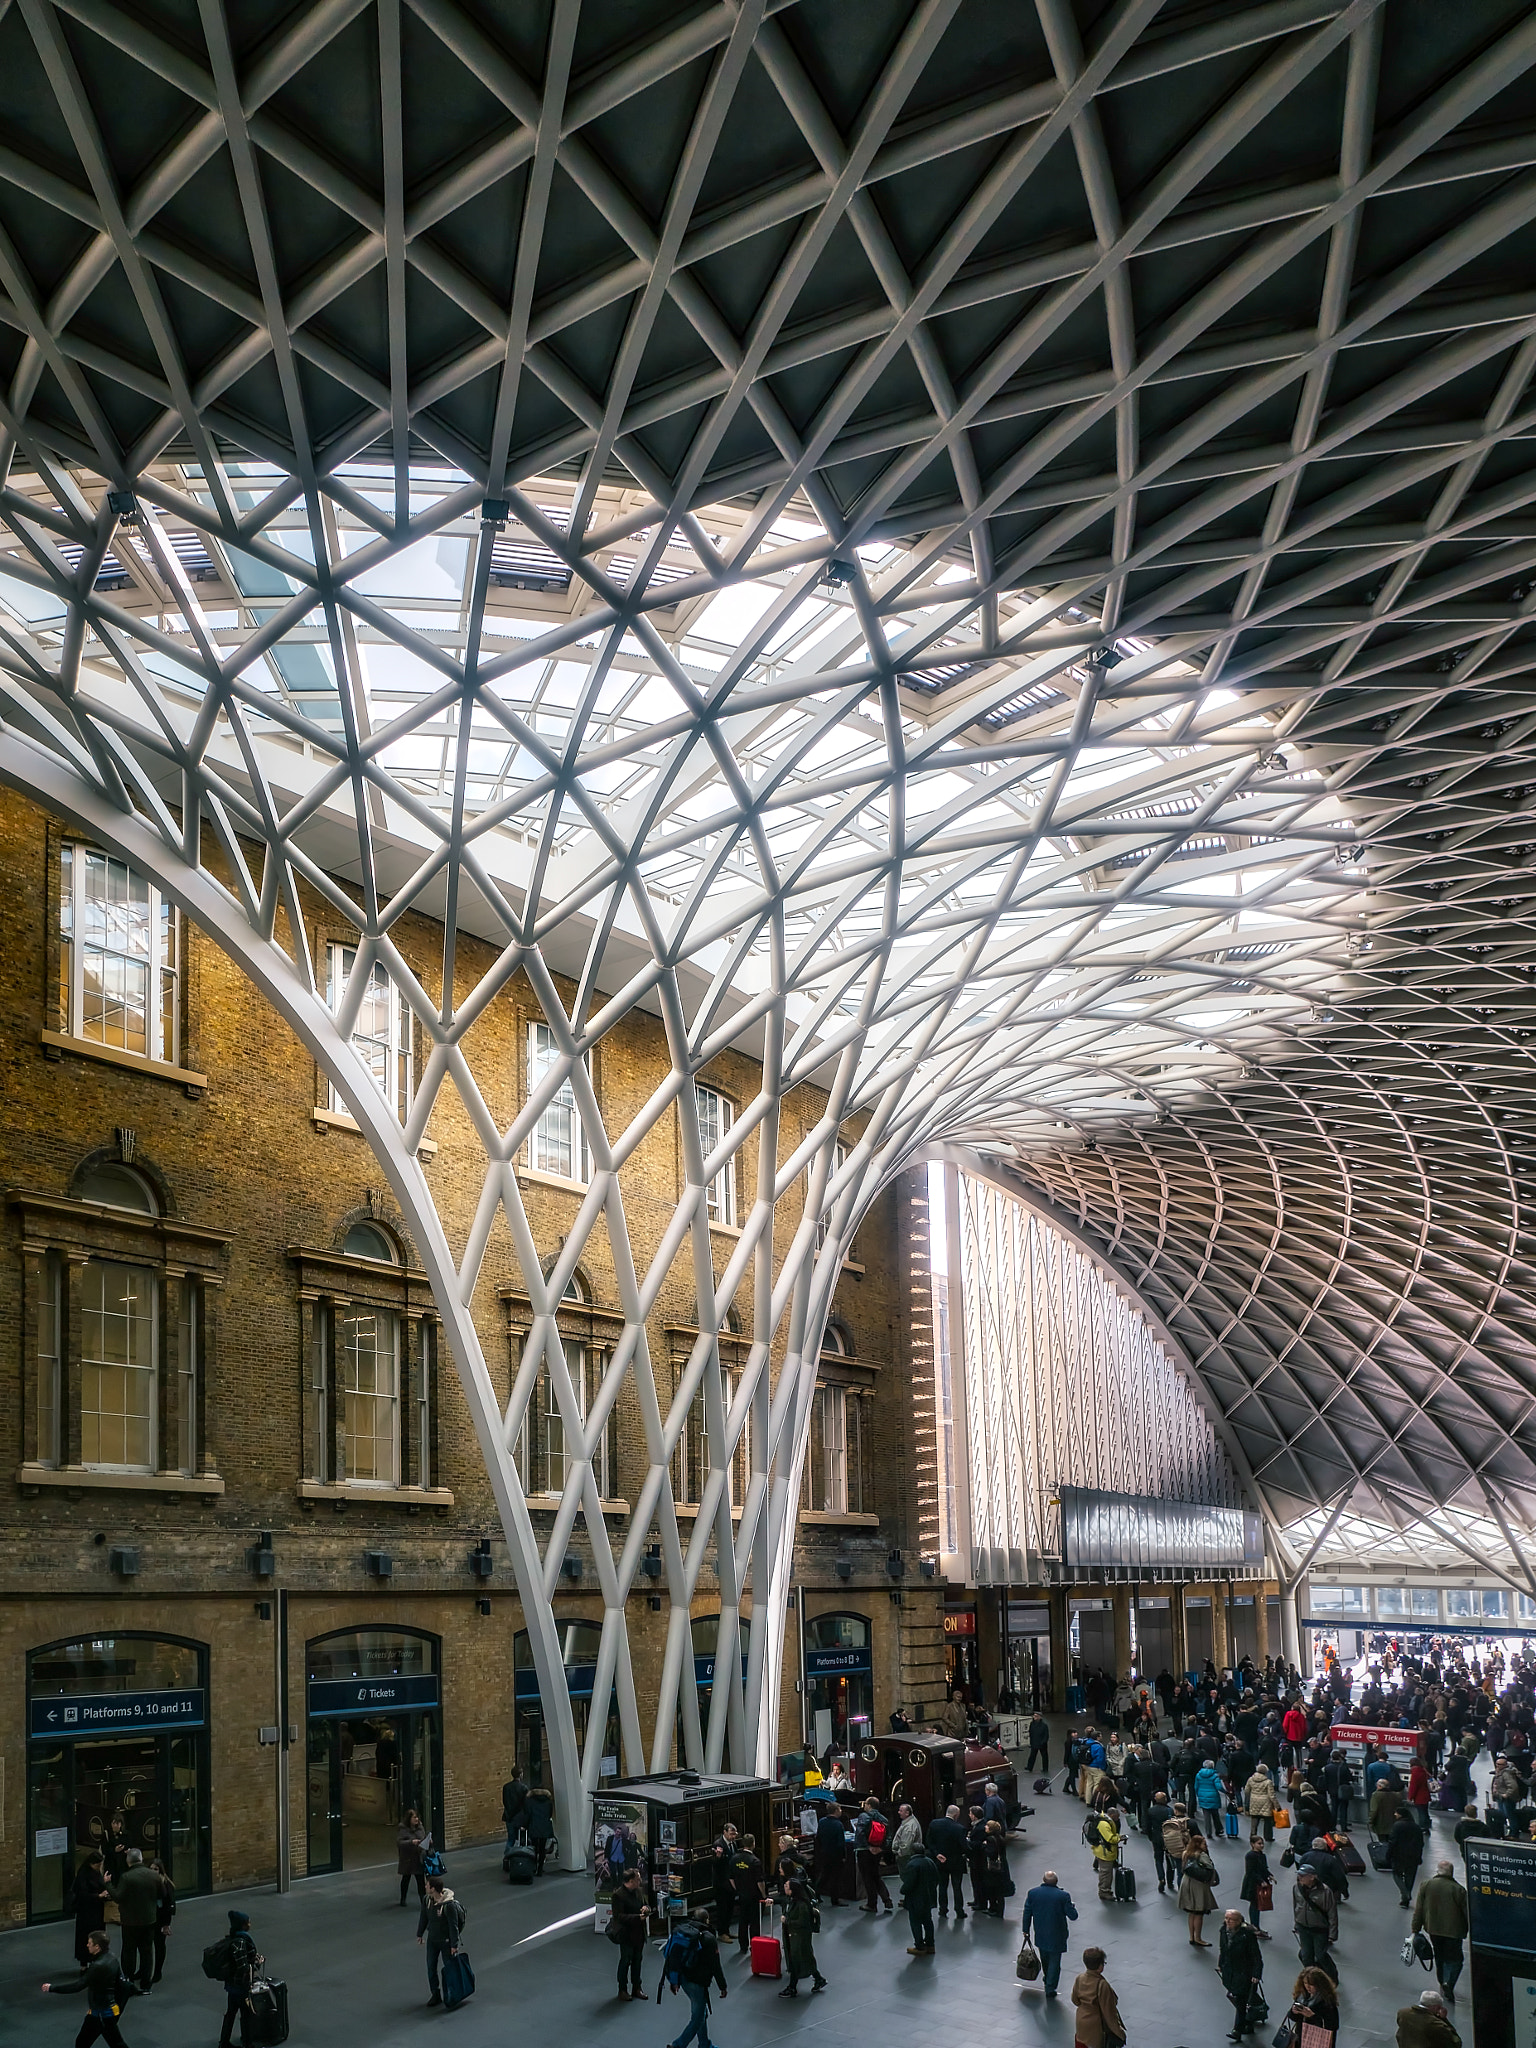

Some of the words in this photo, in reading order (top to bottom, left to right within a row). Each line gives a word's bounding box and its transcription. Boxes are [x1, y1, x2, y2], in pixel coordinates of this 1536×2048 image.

[817, 1657, 836, 1666] Platforms
[368, 1688, 396, 1699] Tickets
[83, 1706, 132, 1720] Platforms
[134, 1704, 144, 1717] 9,
[146, 1704, 159, 1715] 10
[161, 1702, 179, 1714] and
[180, 1701, 193, 1712] 11
[1336, 1730, 1363, 1739] Tickets
[1384, 1734, 1411, 1743] Tickets
[1492, 1854, 1527, 1865] Platforms
[1527, 1858, 1534, 1866] 0
[1492, 1866, 1516, 1876] Dining
[1492, 1877, 1511, 1885] Taxis
[1493, 1888, 1509, 1897] Way
